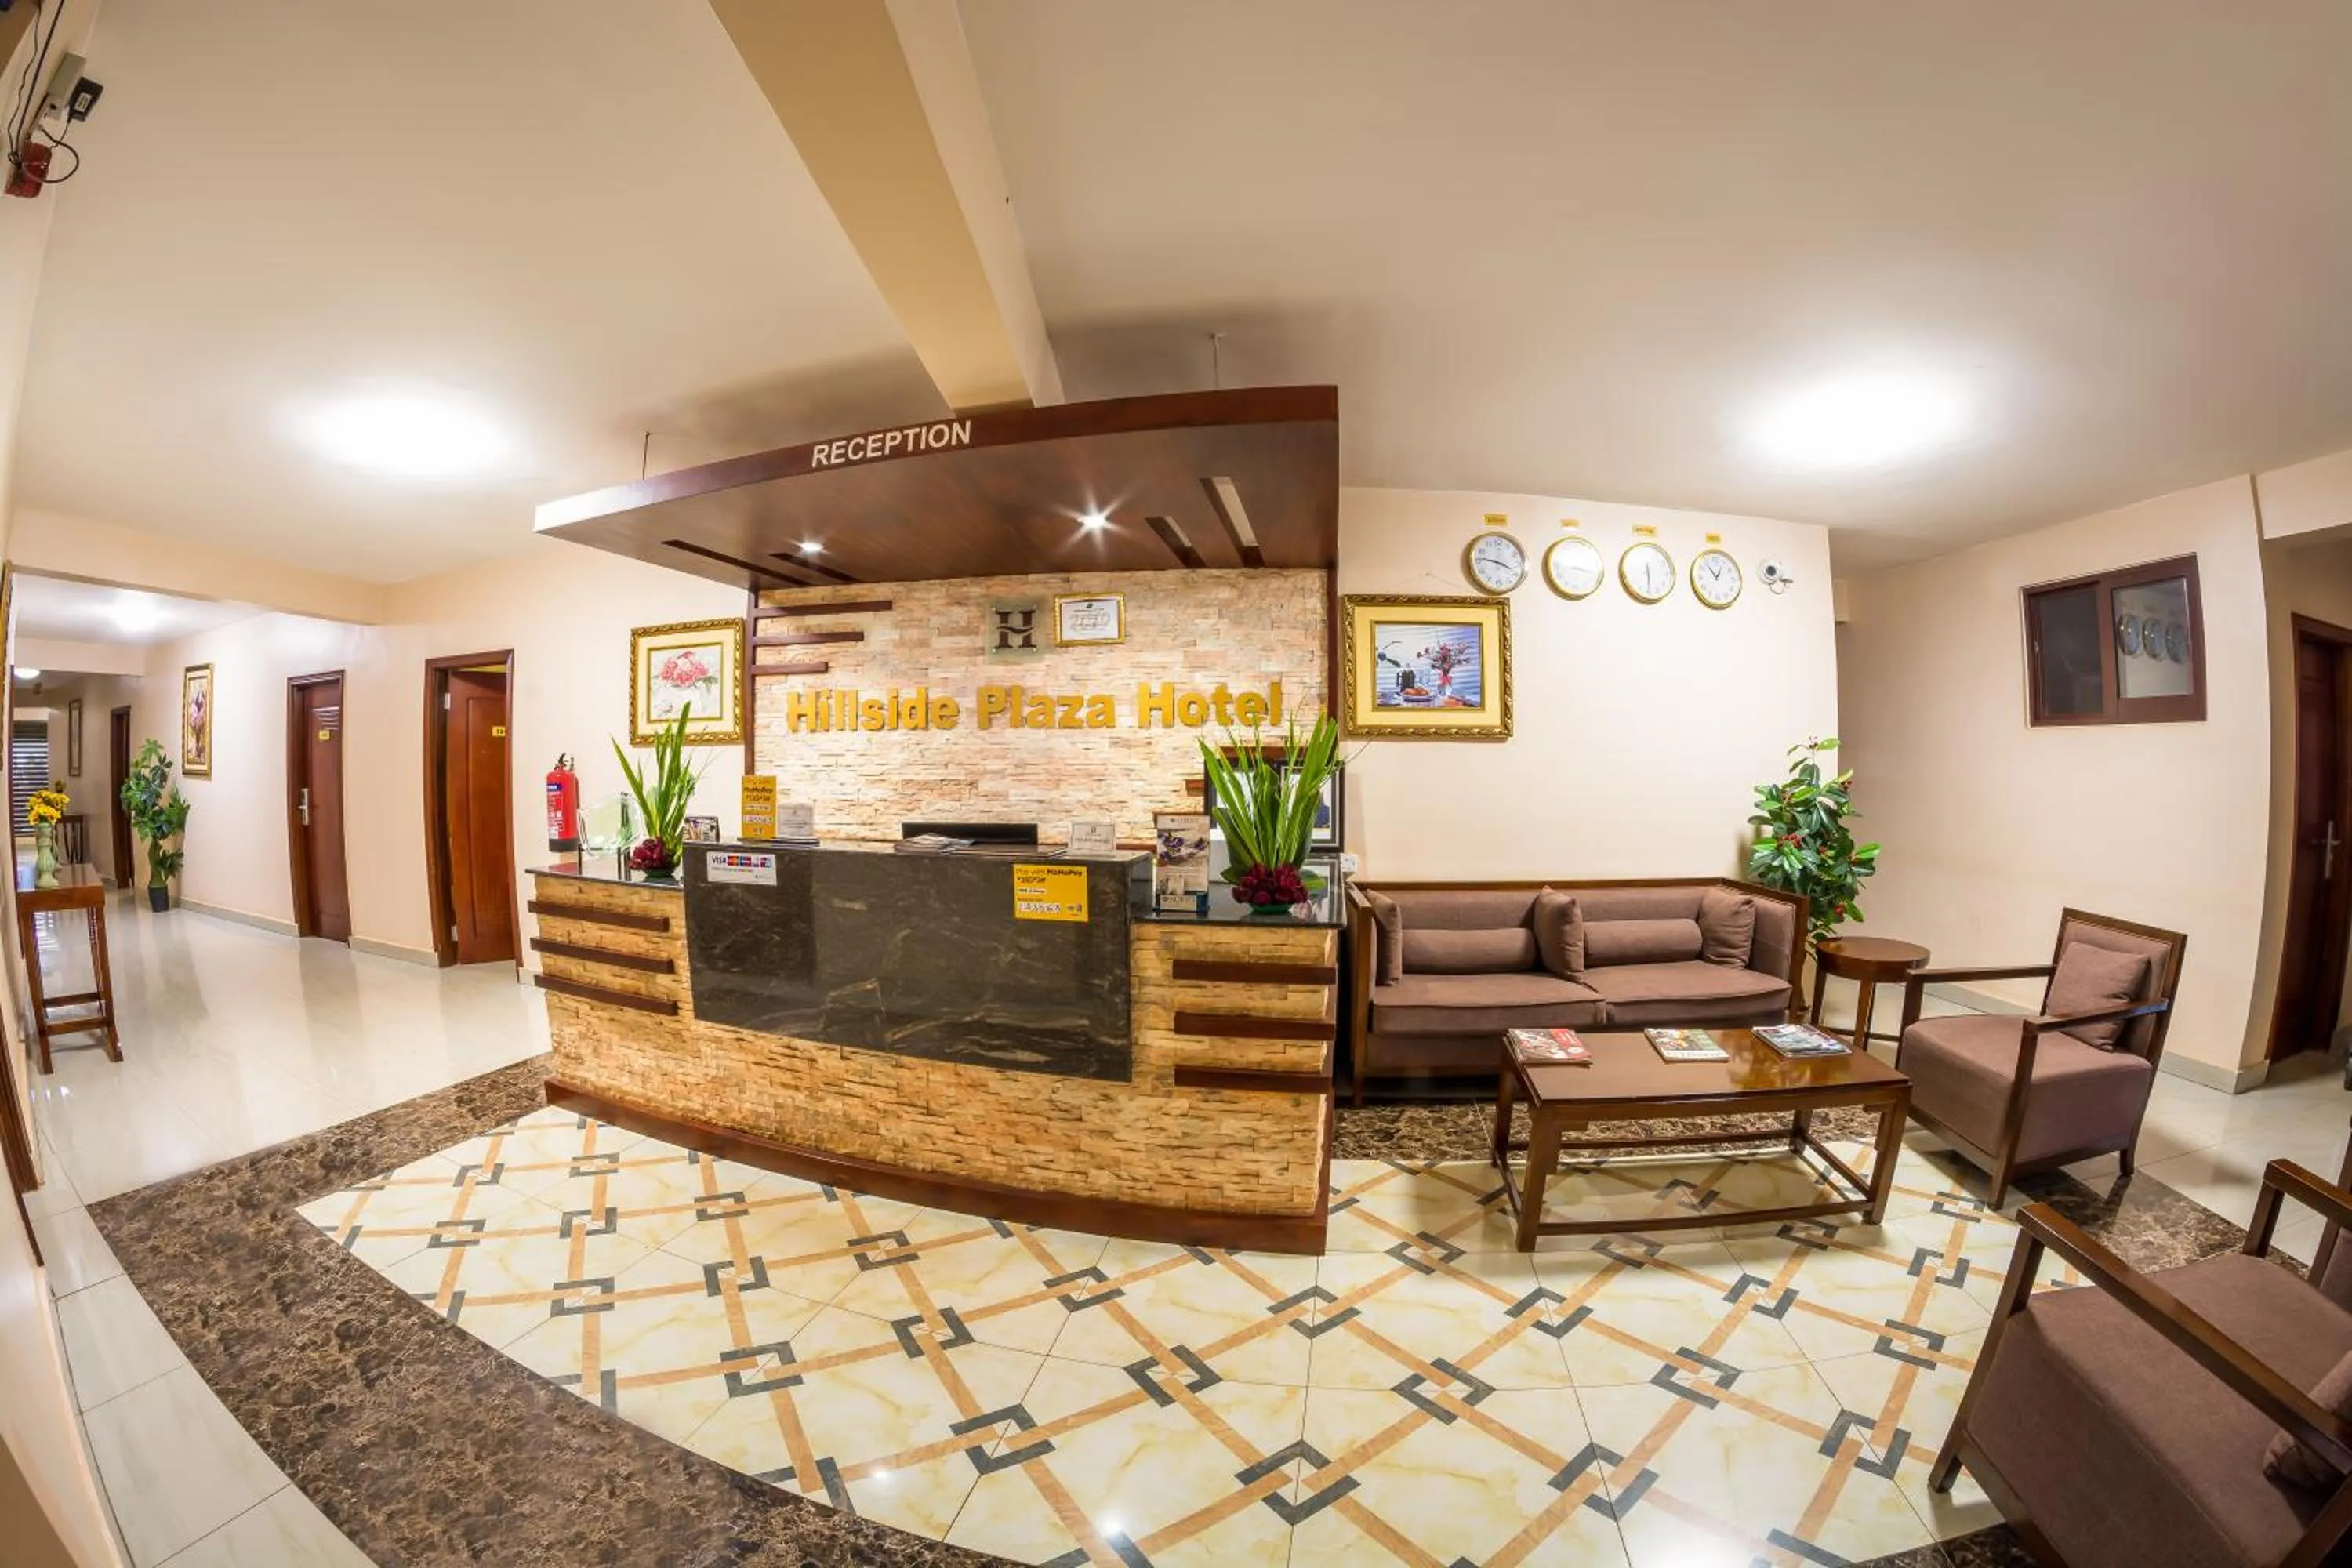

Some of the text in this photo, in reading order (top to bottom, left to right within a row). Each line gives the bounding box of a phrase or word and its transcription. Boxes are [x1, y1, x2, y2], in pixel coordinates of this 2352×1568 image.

[811, 419, 972, 468] RECEPTION
[993, 609, 1037, 649] H
[786, 681, 1283, 733] Hillside Plaza Hotel
